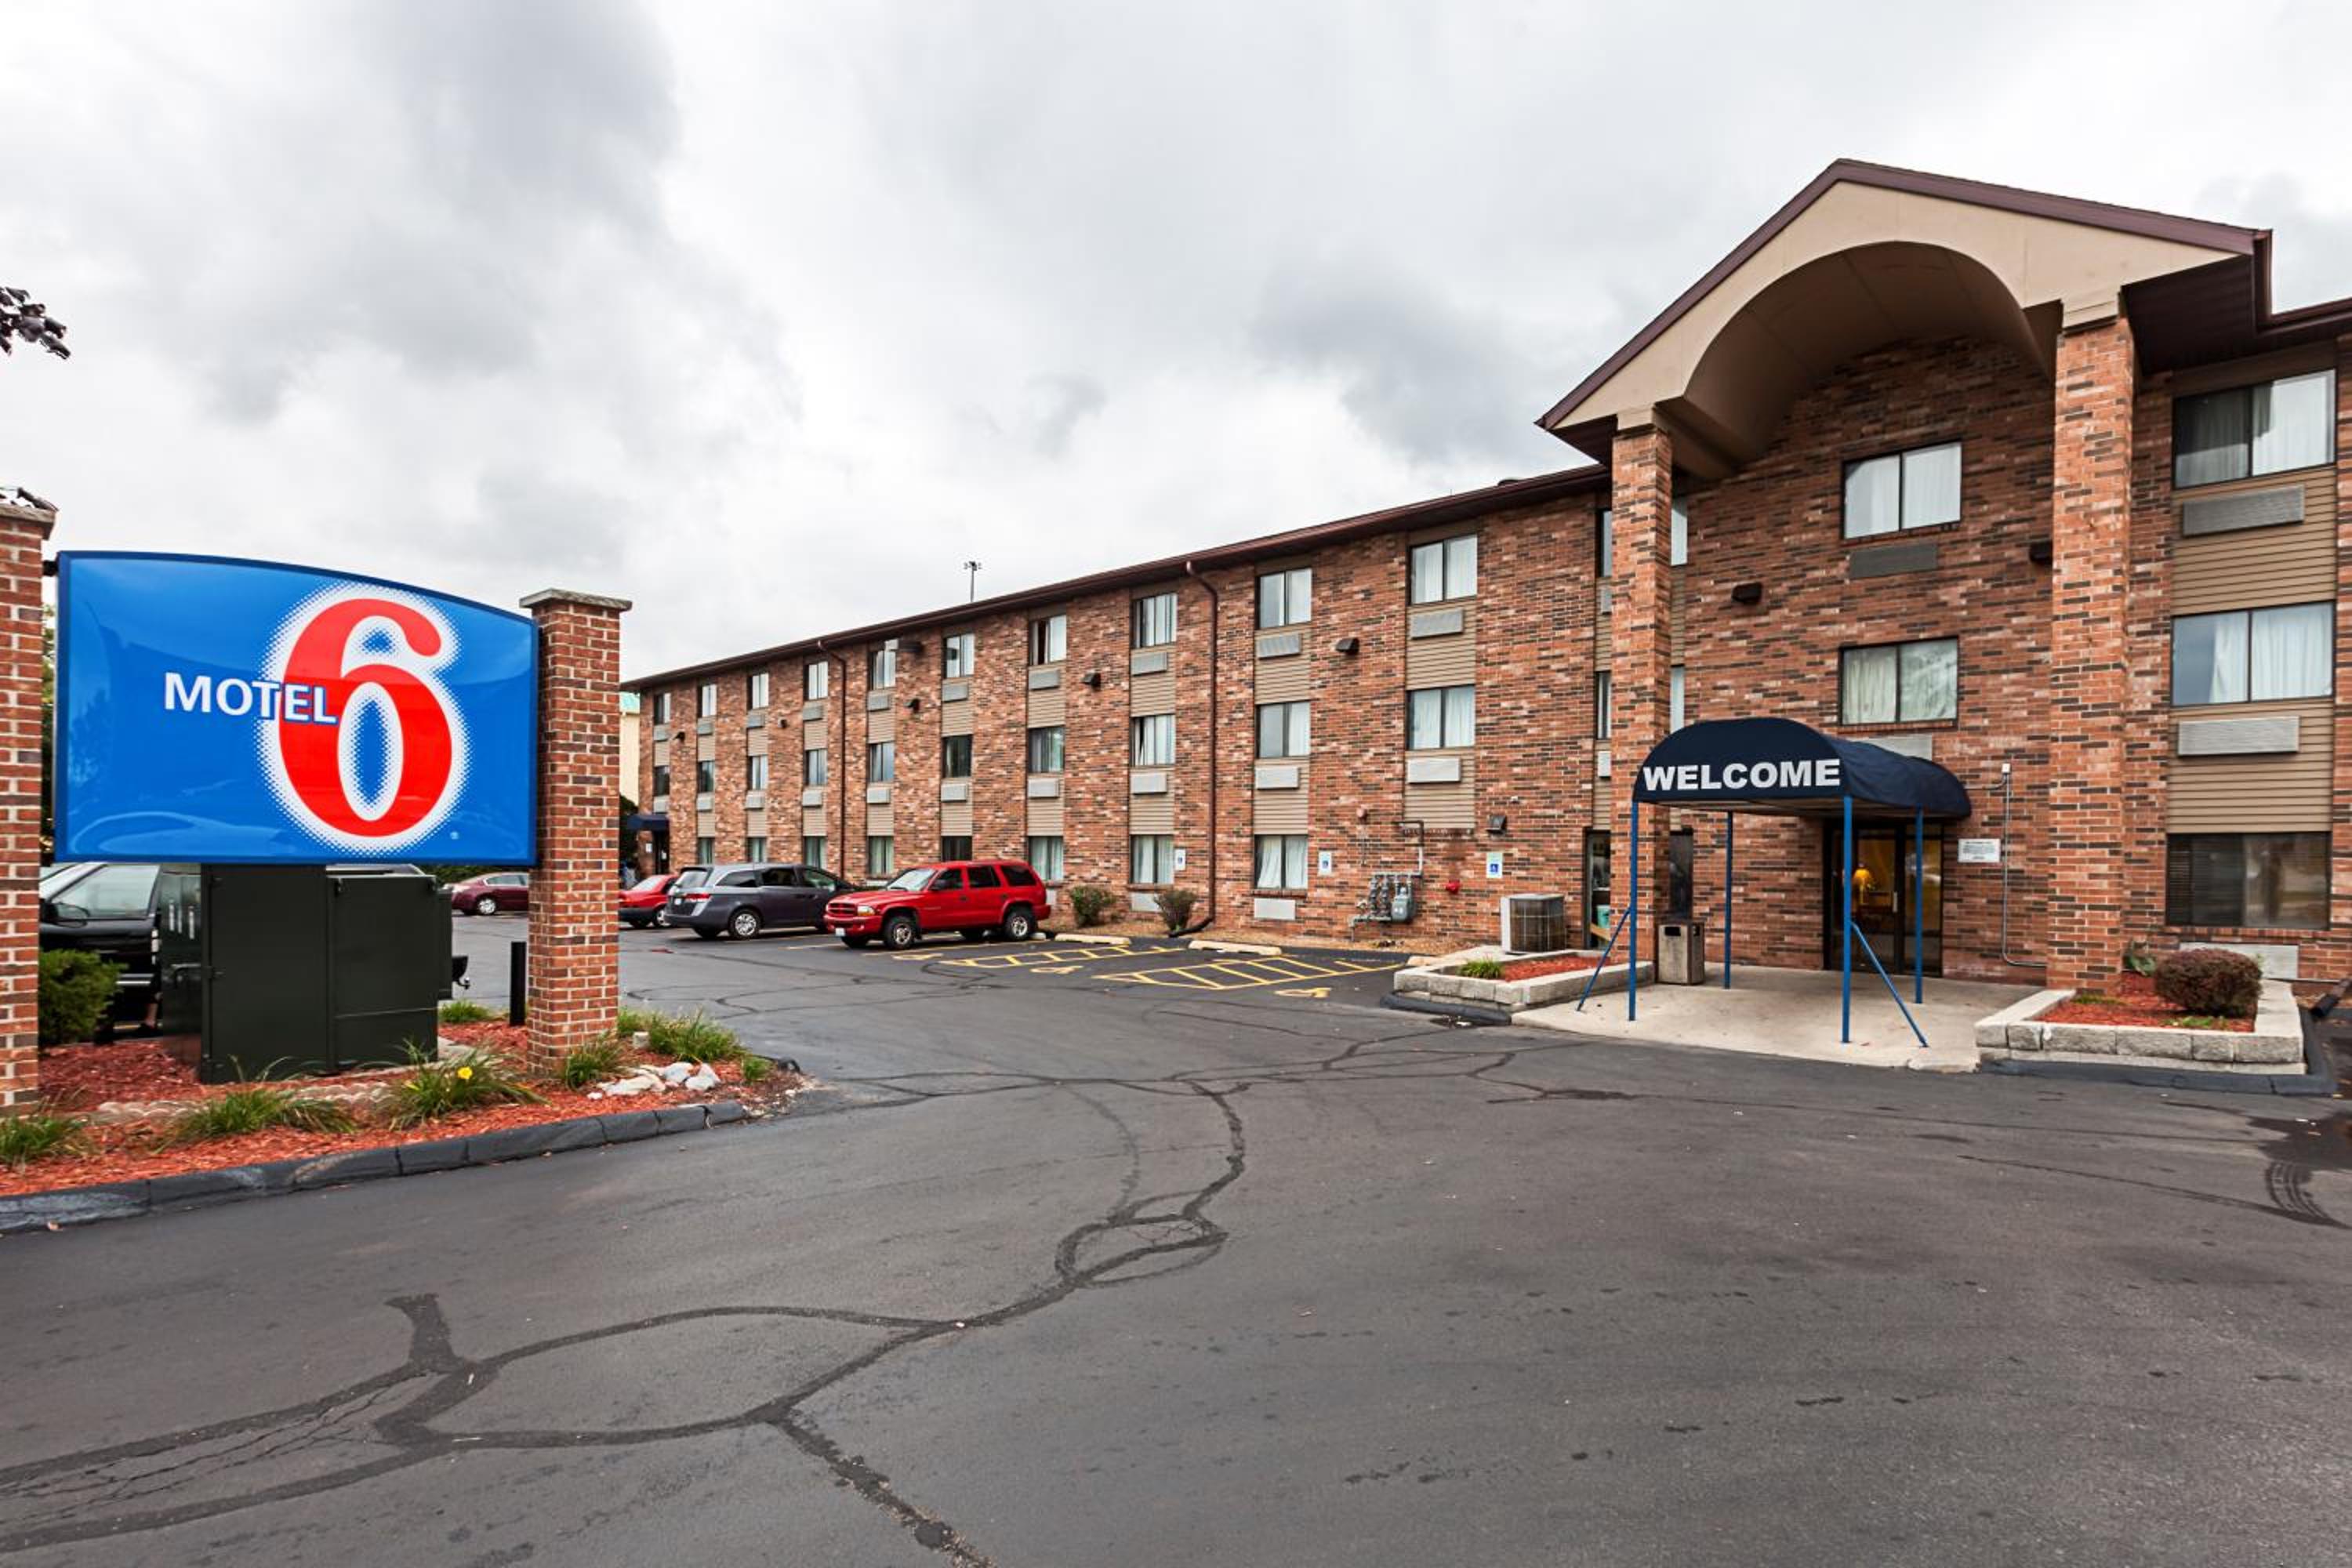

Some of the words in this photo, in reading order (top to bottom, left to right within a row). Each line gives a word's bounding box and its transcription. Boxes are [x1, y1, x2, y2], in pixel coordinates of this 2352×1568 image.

[164, 672, 338, 724] MOTEL
[278, 598, 452, 837] 6
[1642, 759, 1841, 791] WELCOME
